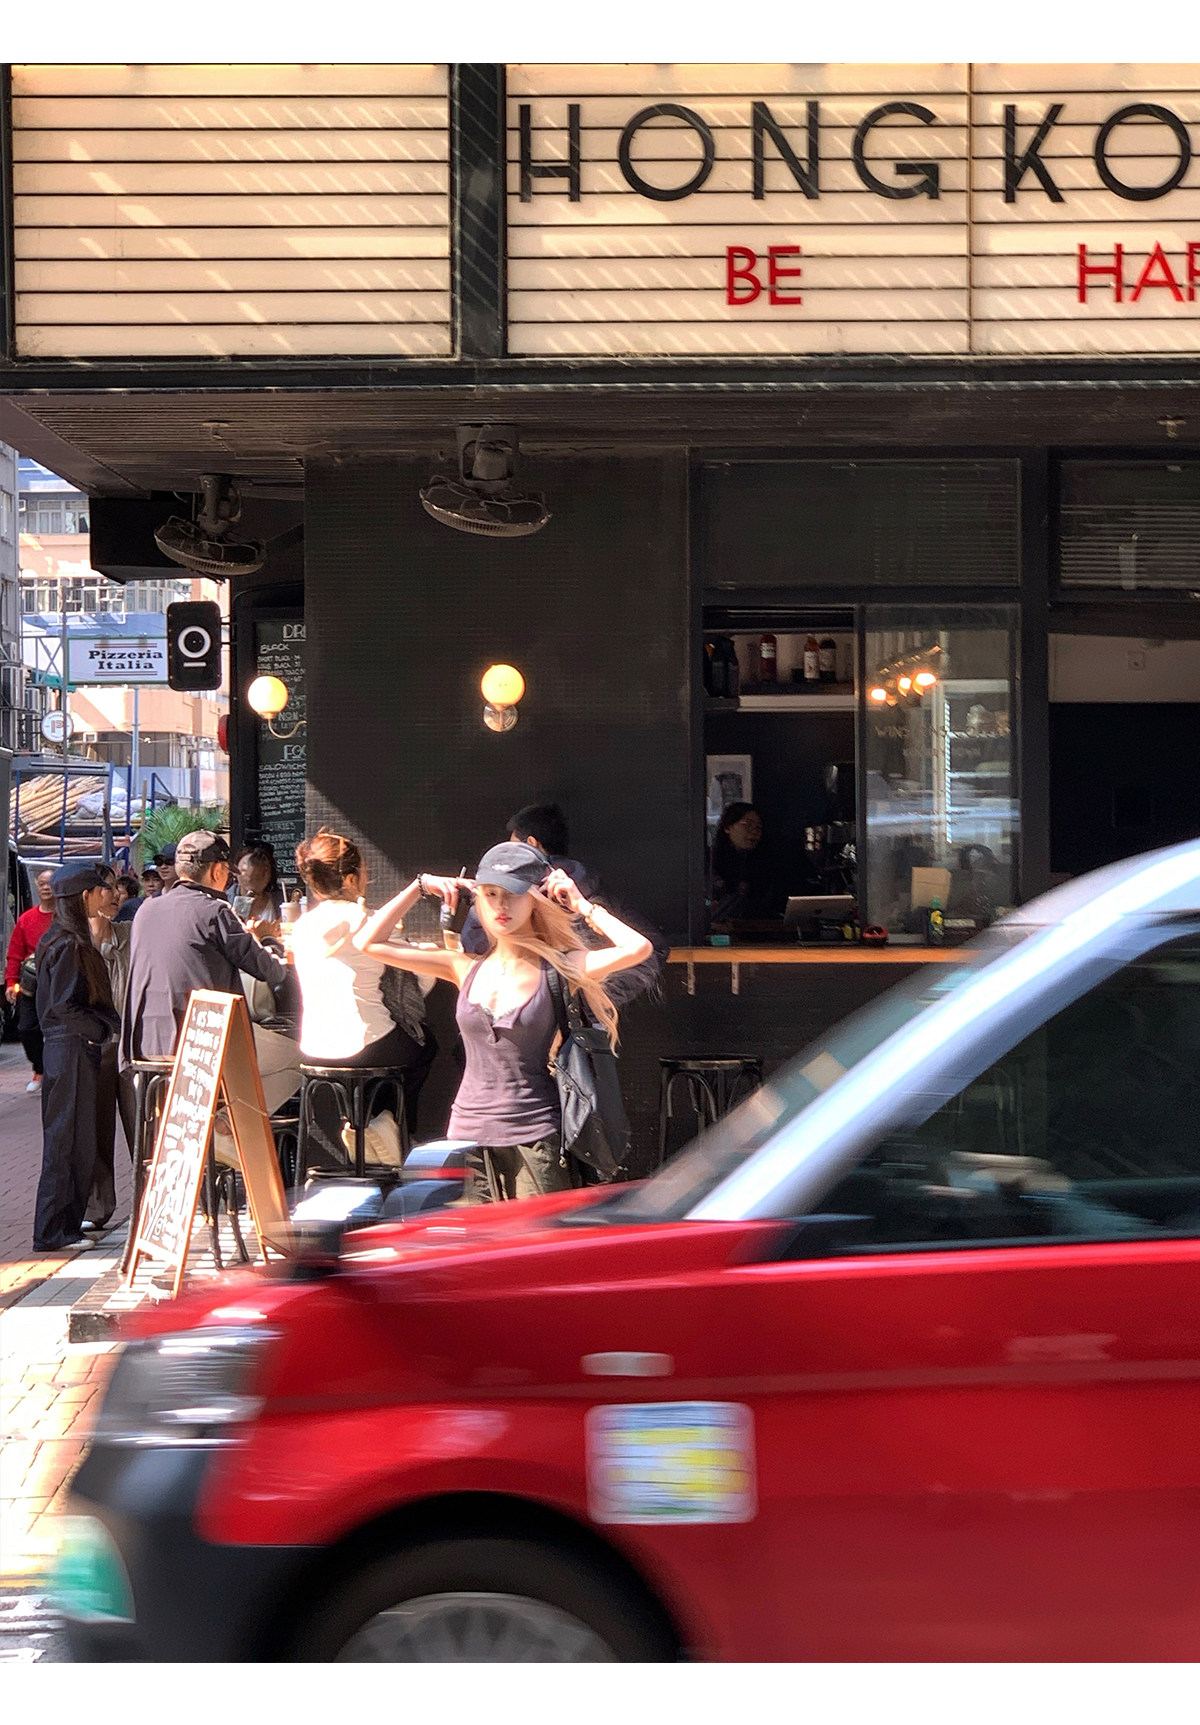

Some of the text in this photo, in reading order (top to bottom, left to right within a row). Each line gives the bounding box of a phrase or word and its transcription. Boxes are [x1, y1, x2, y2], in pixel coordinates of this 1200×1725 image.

[519, 101, 1191, 204] HONG KO
[726, 245, 802, 306] BE
[88, 649, 163, 660] Pizzeria
[97, 660, 154, 670] Italia
